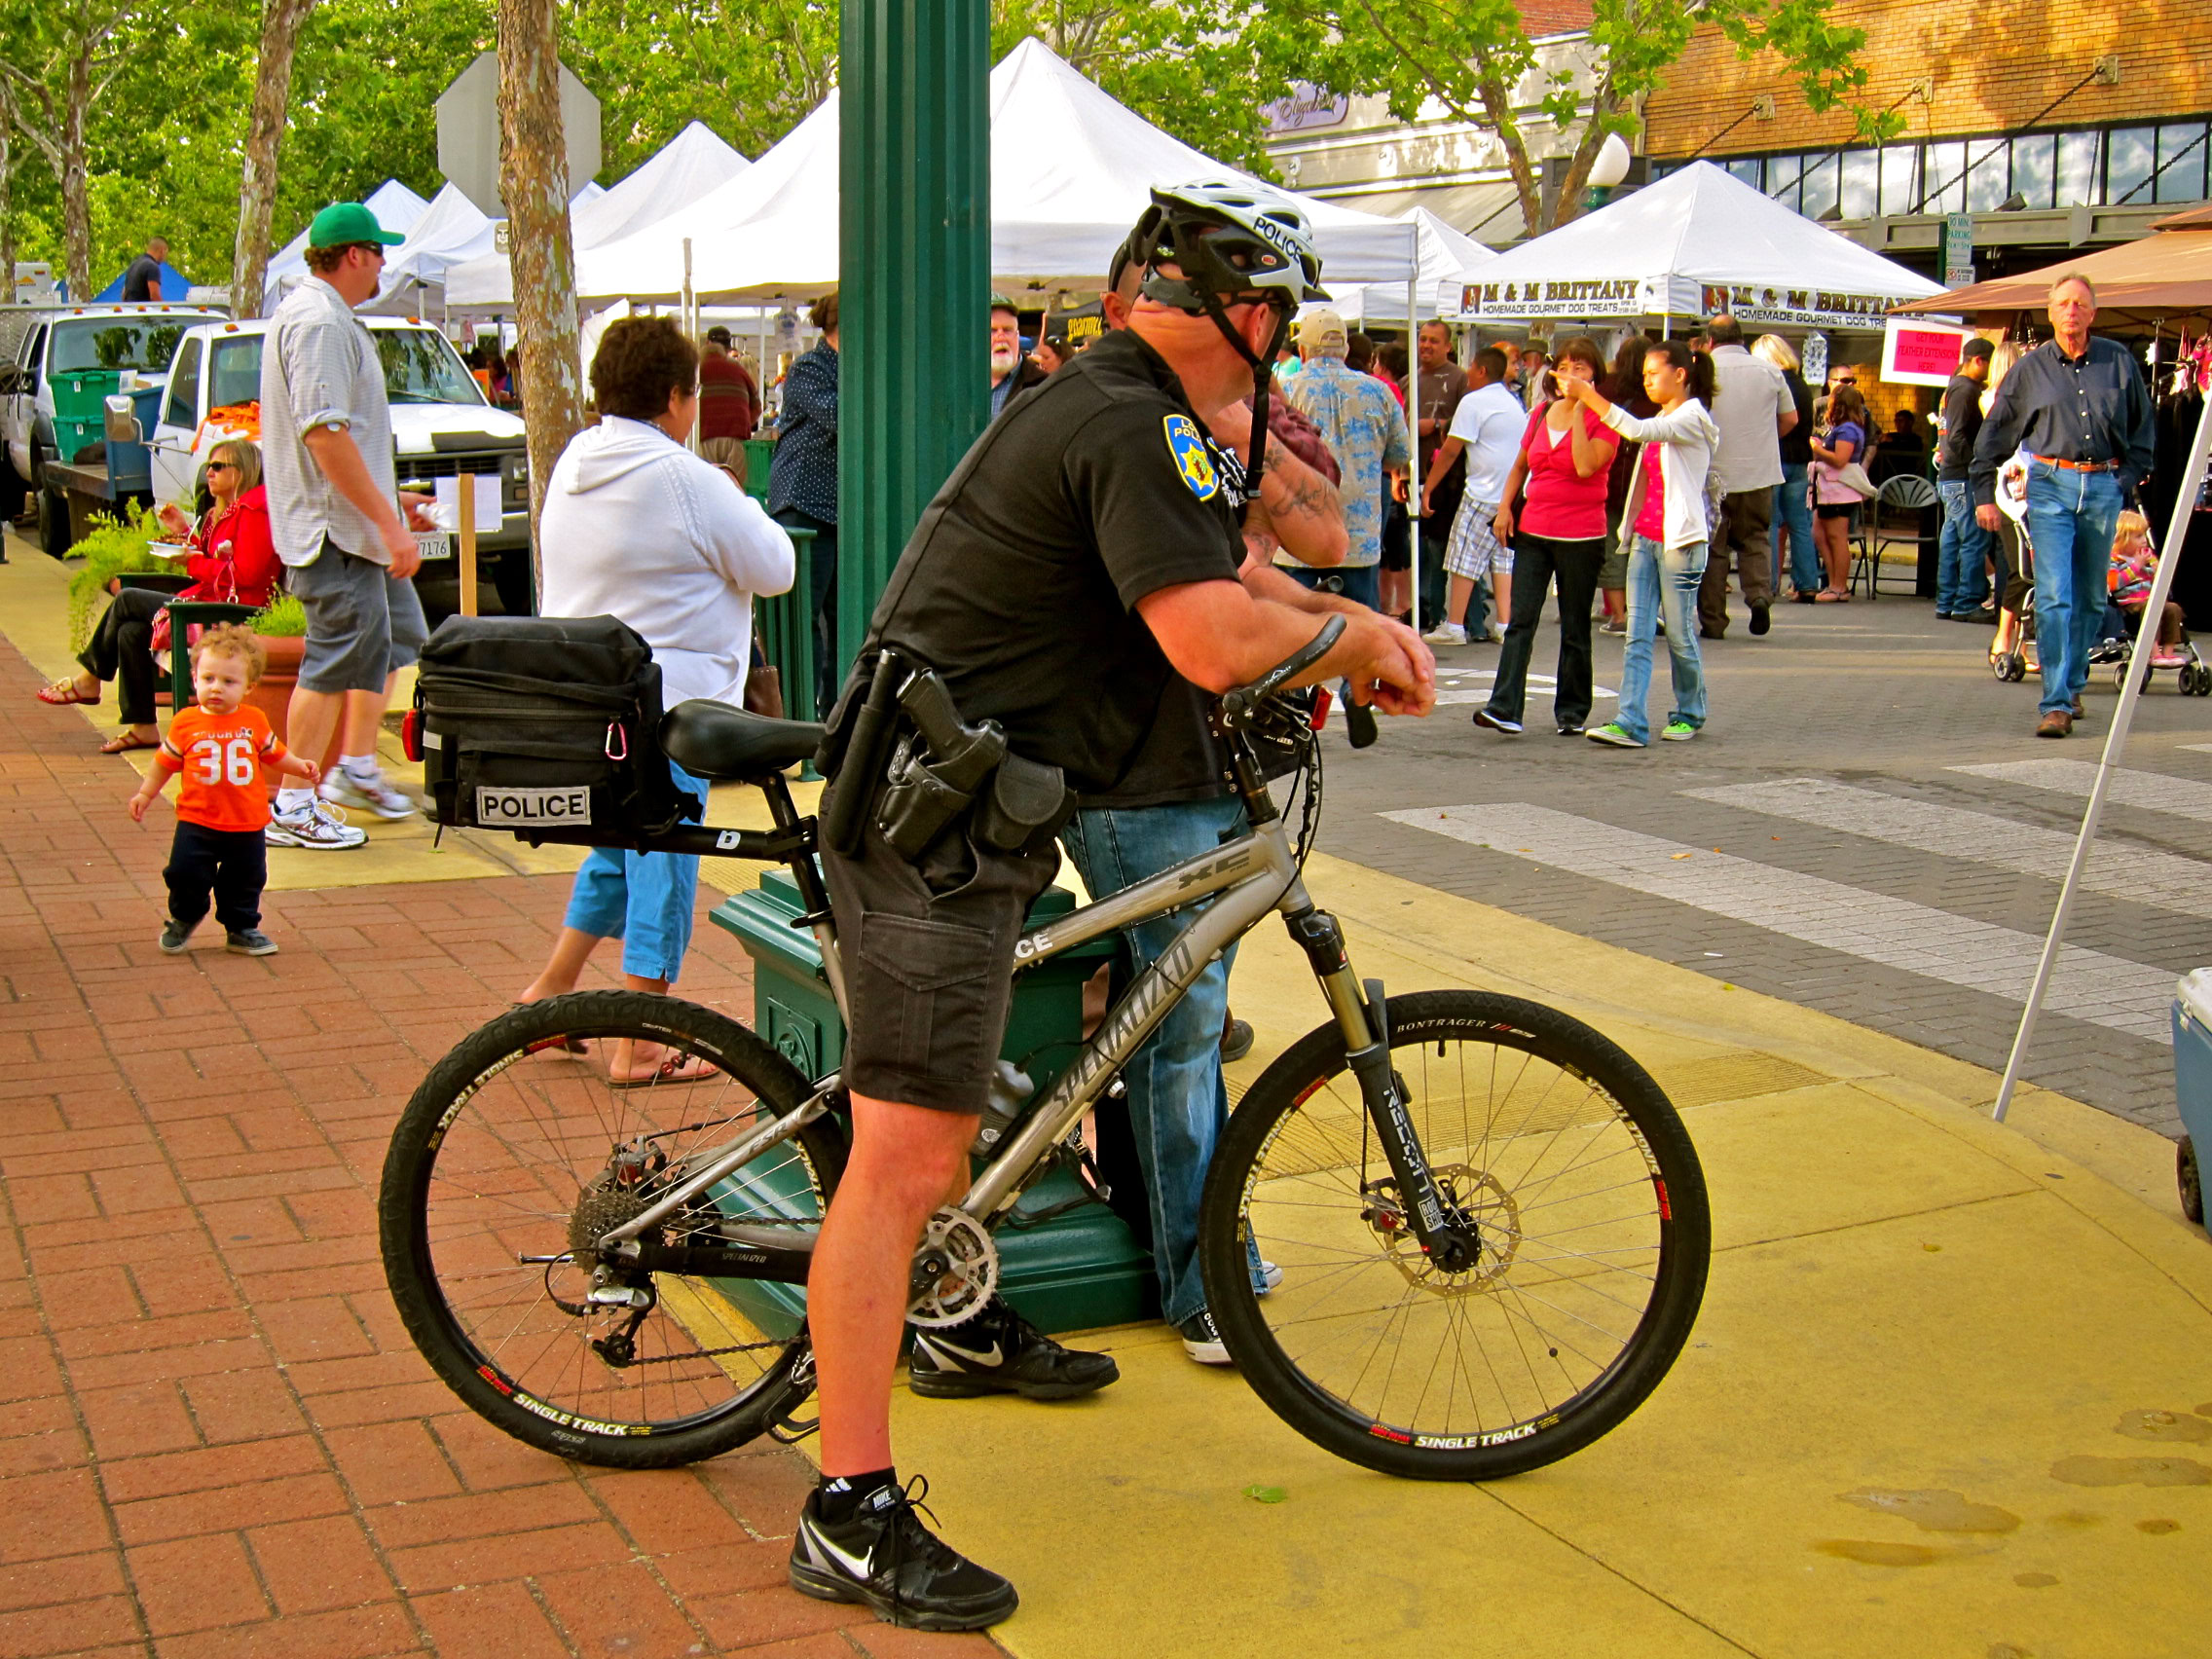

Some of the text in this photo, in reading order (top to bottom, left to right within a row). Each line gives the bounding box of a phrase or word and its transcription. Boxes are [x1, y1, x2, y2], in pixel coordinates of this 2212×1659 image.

[1252, 216, 1304, 264] POLICE
[1483, 279, 1641, 303] M & M BRITTANY
[1732, 286, 1753, 306] M
[1761, 288, 1779, 309] &
[1788, 290, 1808, 310] M
[1482, 304, 1527, 314] HOMEMADE
[1529, 302, 1567, 313] GOURMET
[1568, 301, 1586, 313] DOG
[1588, 300, 1619, 312] TREATS
[1734, 309, 1886, 327] HOMEMADE GOURMET DOG TRE
[417, 541, 447, 555] 7176
[192, 739, 254, 786] 36
[484, 793, 586, 819] POLICE
[1051, 940, 1195, 1112] SPECIALIZED
[1396, 1019, 1487, 1033] BONTRAGER
[437, 1048, 525, 1130] SINGLE TRACK
[1585, 1075, 1630, 1119] TRACK
[1237, 1106, 1293, 1218] SINGLE TRACK
[721, 1252, 767, 1264] SPECIALIZED
[513, 1392, 629, 1436] SINGLE TRACK
[1415, 1434, 1478, 1450] SINGLE
[1479, 1420, 1537, 1447] TRACK
